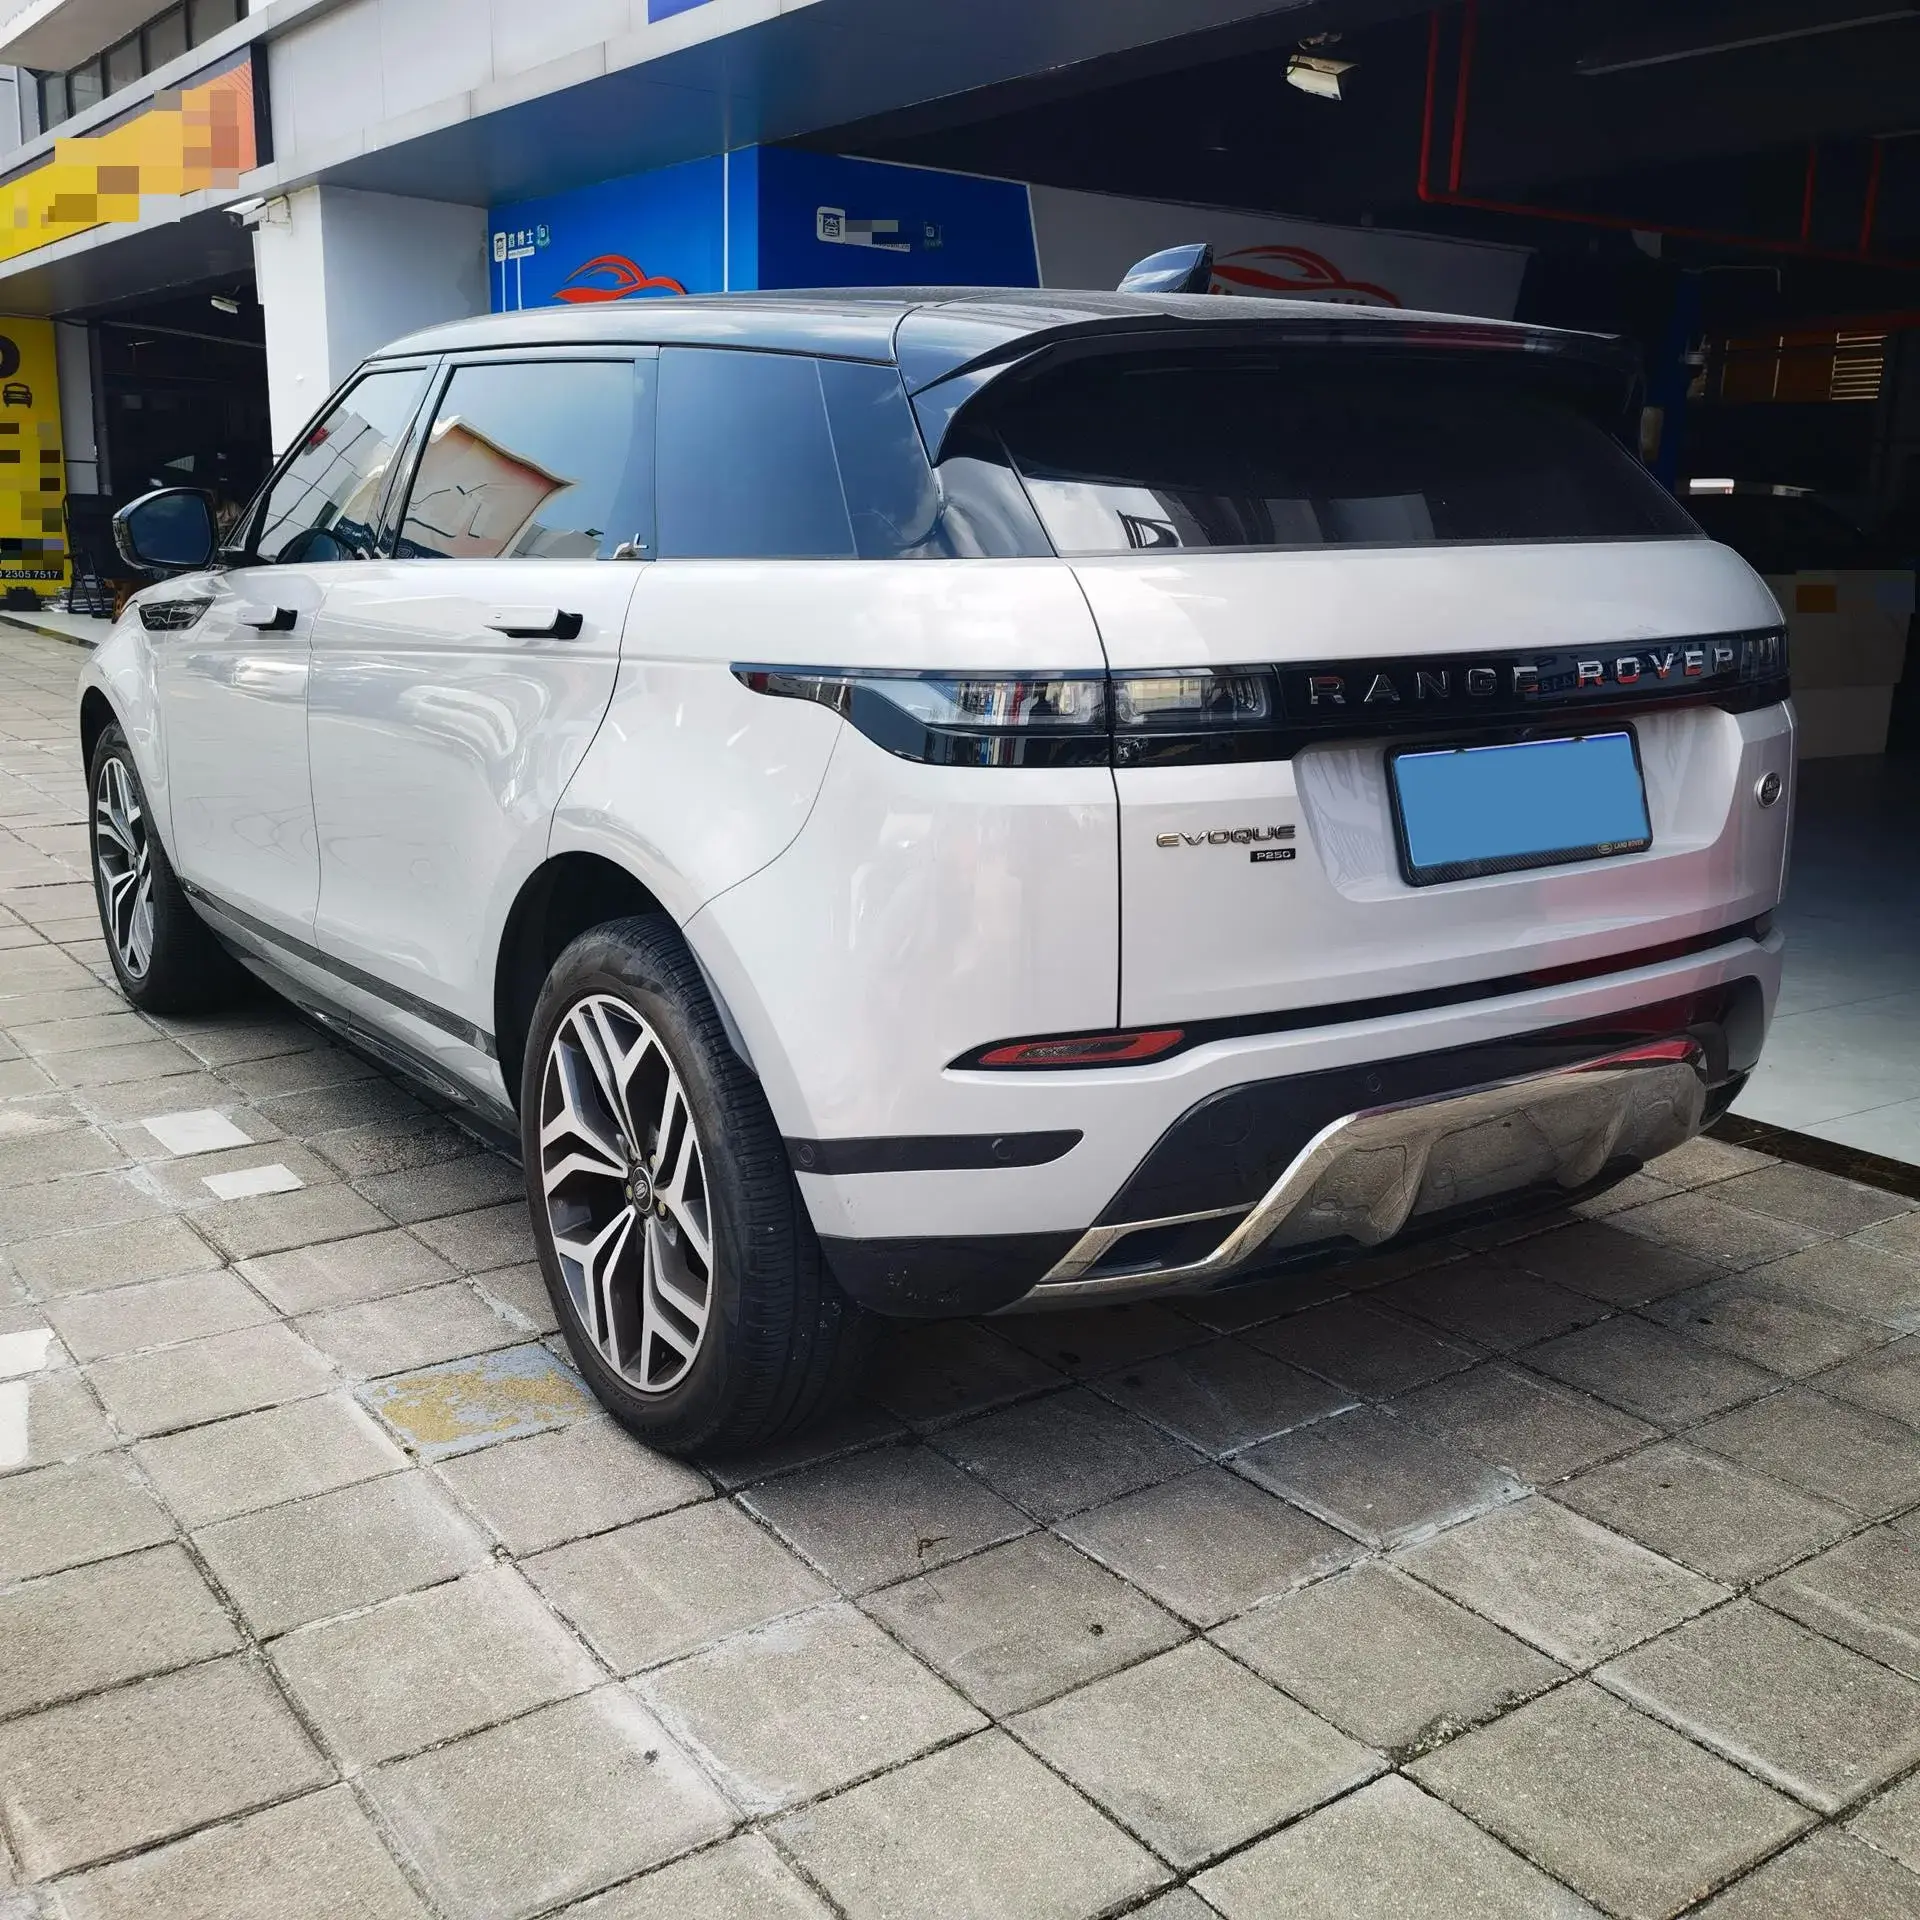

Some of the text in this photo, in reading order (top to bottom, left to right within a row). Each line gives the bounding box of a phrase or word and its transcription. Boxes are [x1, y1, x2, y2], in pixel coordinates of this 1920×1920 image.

[5, 570, 58, 578] 2305 7517
[1309, 665, 1539, 704] RANGE
[1576, 647, 1734, 688] ROVER
[1156, 824, 1296, 848] EVOQUE
[1256, 850, 1291, 860] P250
